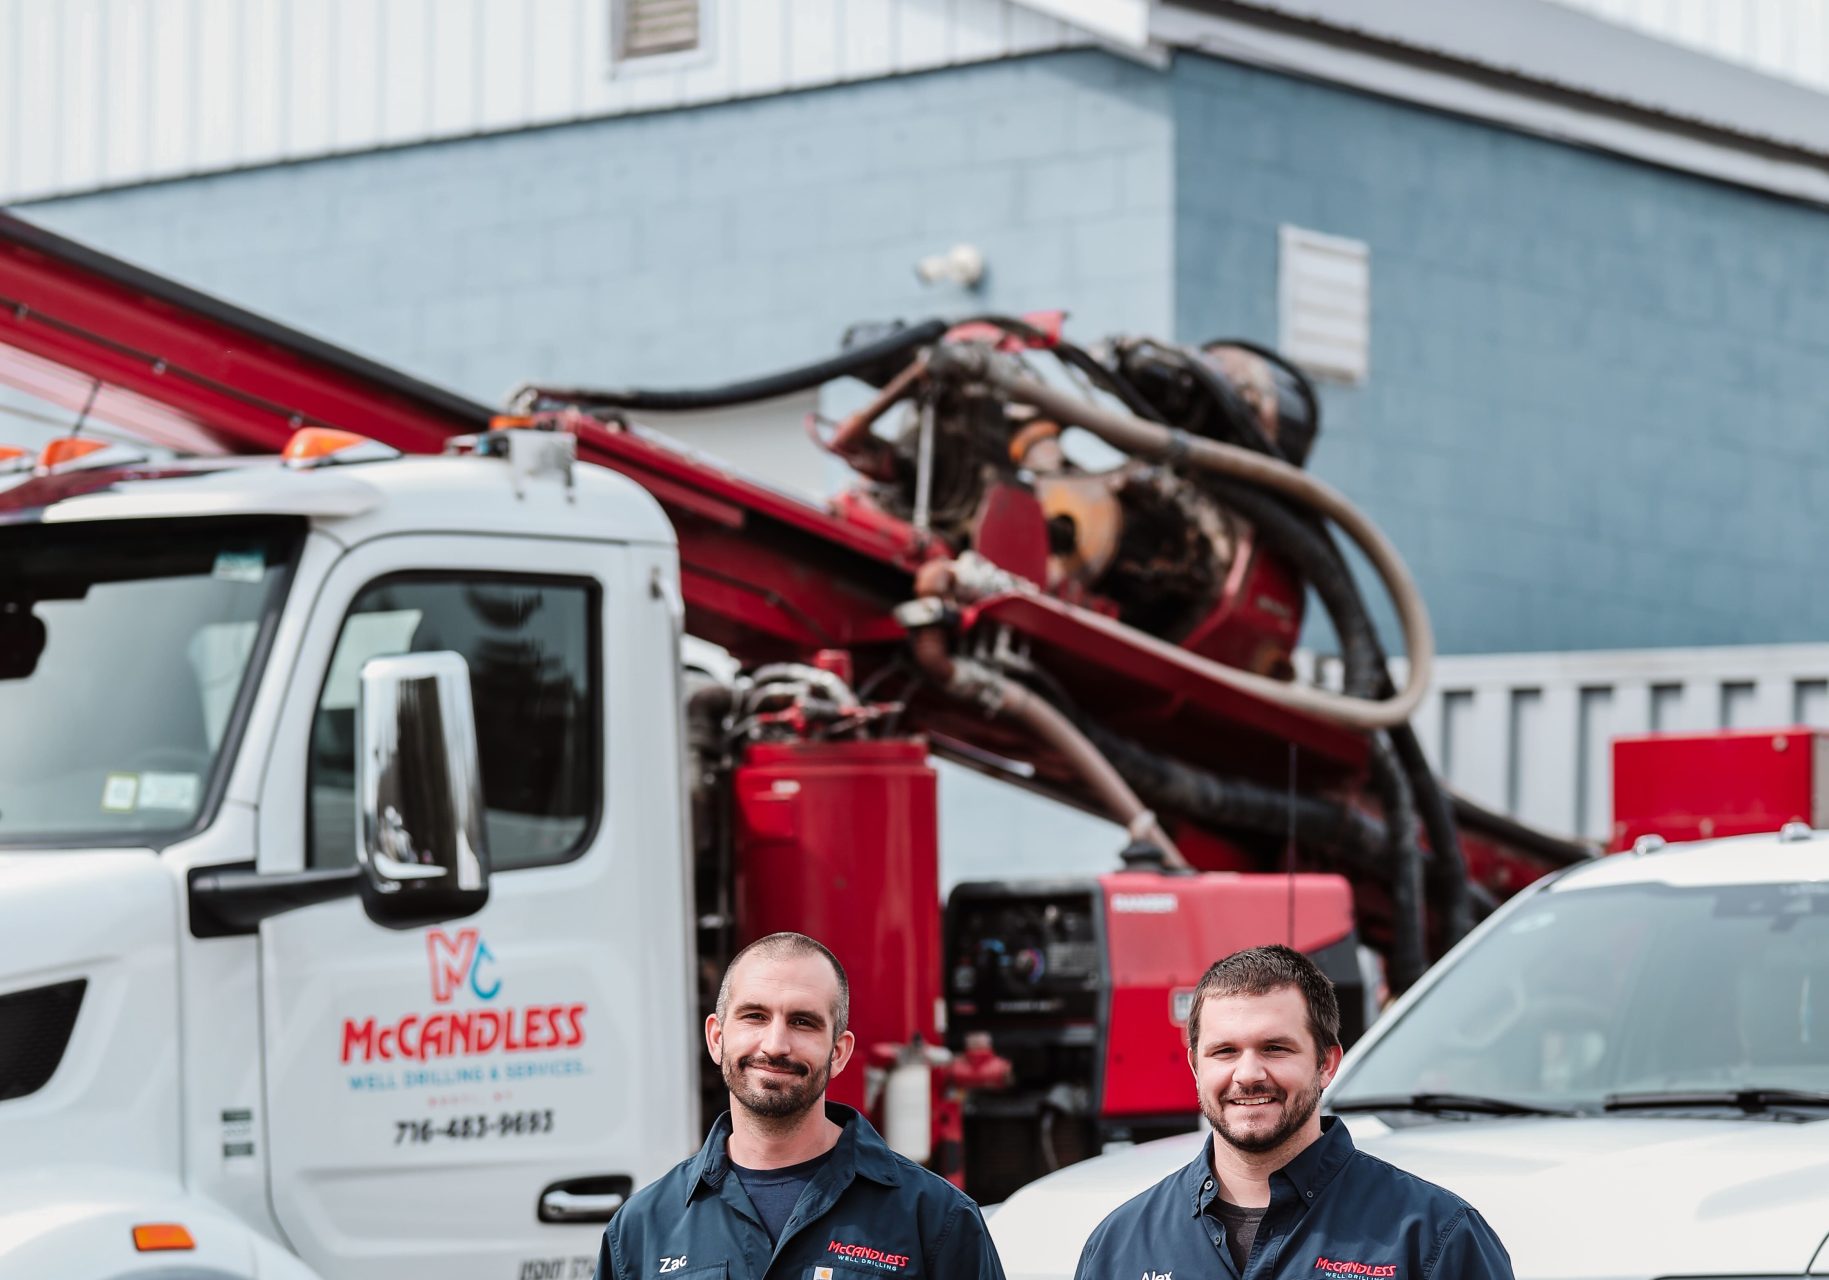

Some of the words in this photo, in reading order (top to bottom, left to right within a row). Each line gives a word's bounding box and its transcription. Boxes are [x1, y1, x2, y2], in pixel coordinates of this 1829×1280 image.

[340, 1003, 587, 1064] McCANDLESS
[349, 1074, 396, 1092] WELL
[403, 1068, 484, 1088] DRILLING
[828, 1240, 909, 1267] McCANDLESS
[838, 1254, 859, 1263] WELL
[861, 1259, 897, 1271] DRILLING
[659, 1255, 687, 1273] Zac
[1316, 1257, 1396, 1276] McCANDLESS
[1325, 1271, 1346, 1279] WELL
